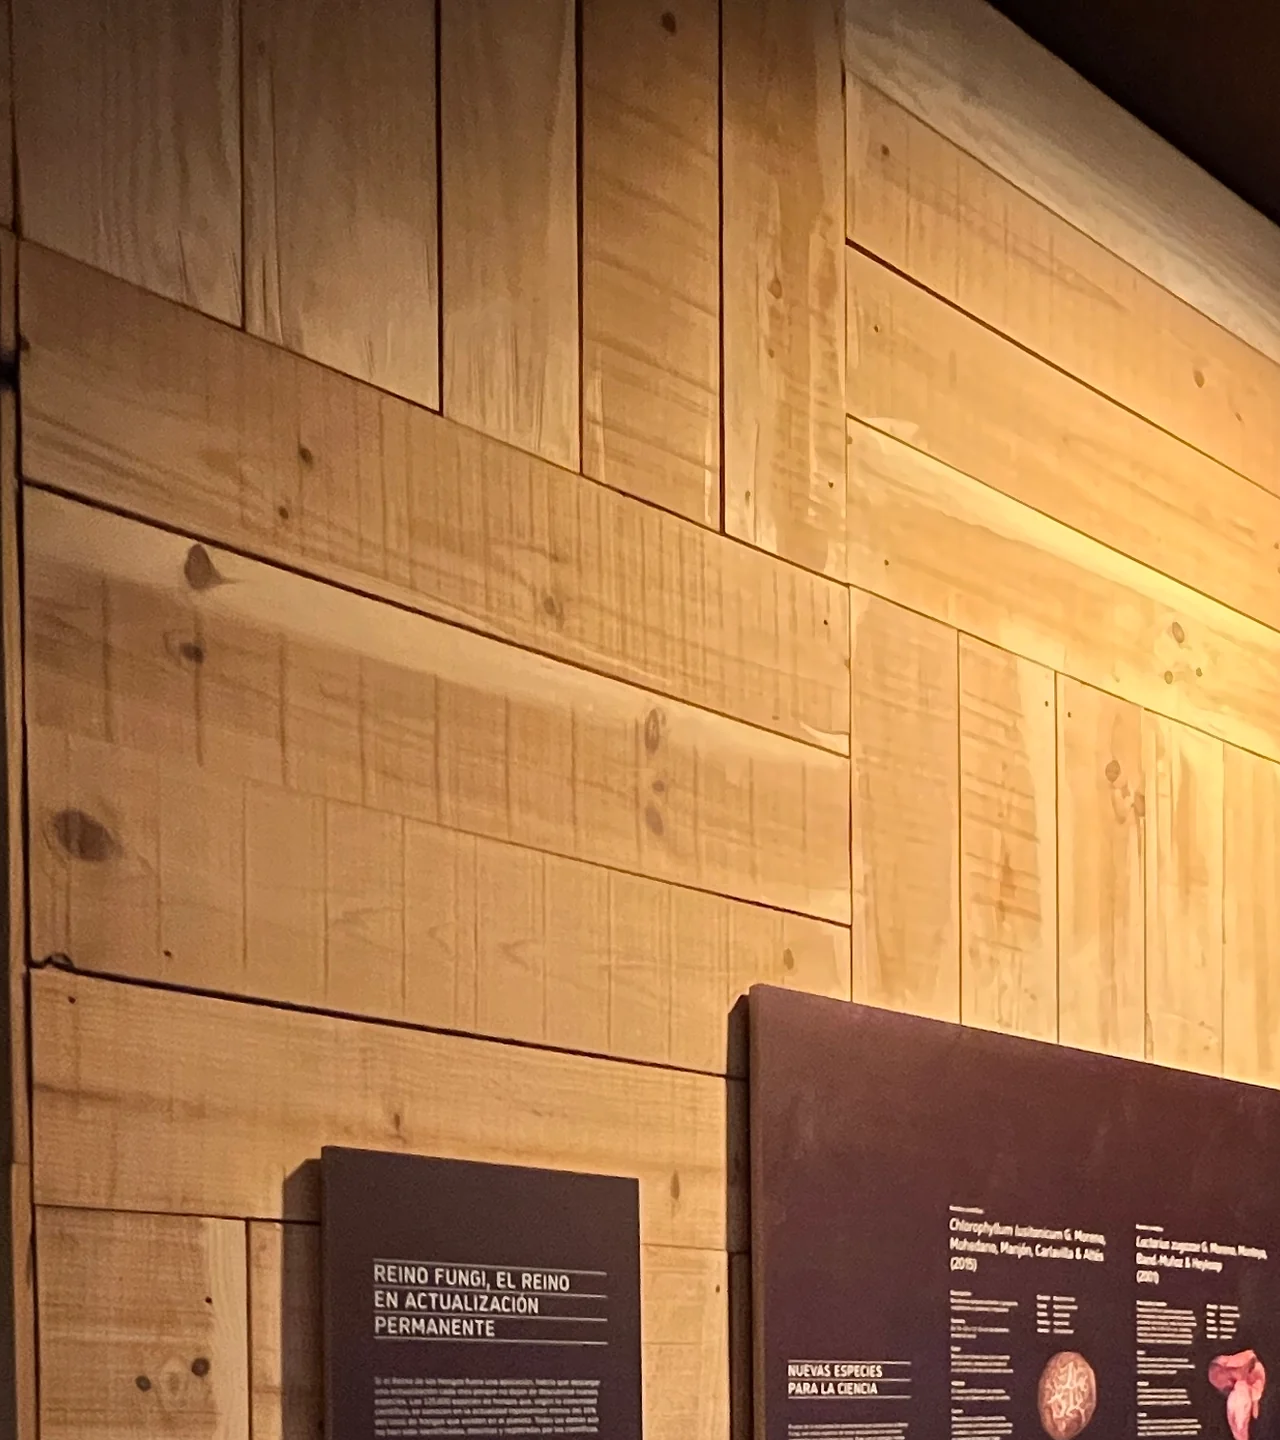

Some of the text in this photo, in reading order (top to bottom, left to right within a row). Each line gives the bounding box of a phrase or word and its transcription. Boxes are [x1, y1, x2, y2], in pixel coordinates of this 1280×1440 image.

[1075, 1247, 1081, 1259] &
[374, 1264, 570, 1292] REINO FUNGI, EL REINO
[374, 1291, 538, 1314] EN ACTUALIZACIÓN
[374, 1316, 494, 1336] PERMANENTE
[788, 1364, 882, 1378] NUEVAS ESPECIES
[788, 1382, 878, 1395] PARA LA CIENCIA
